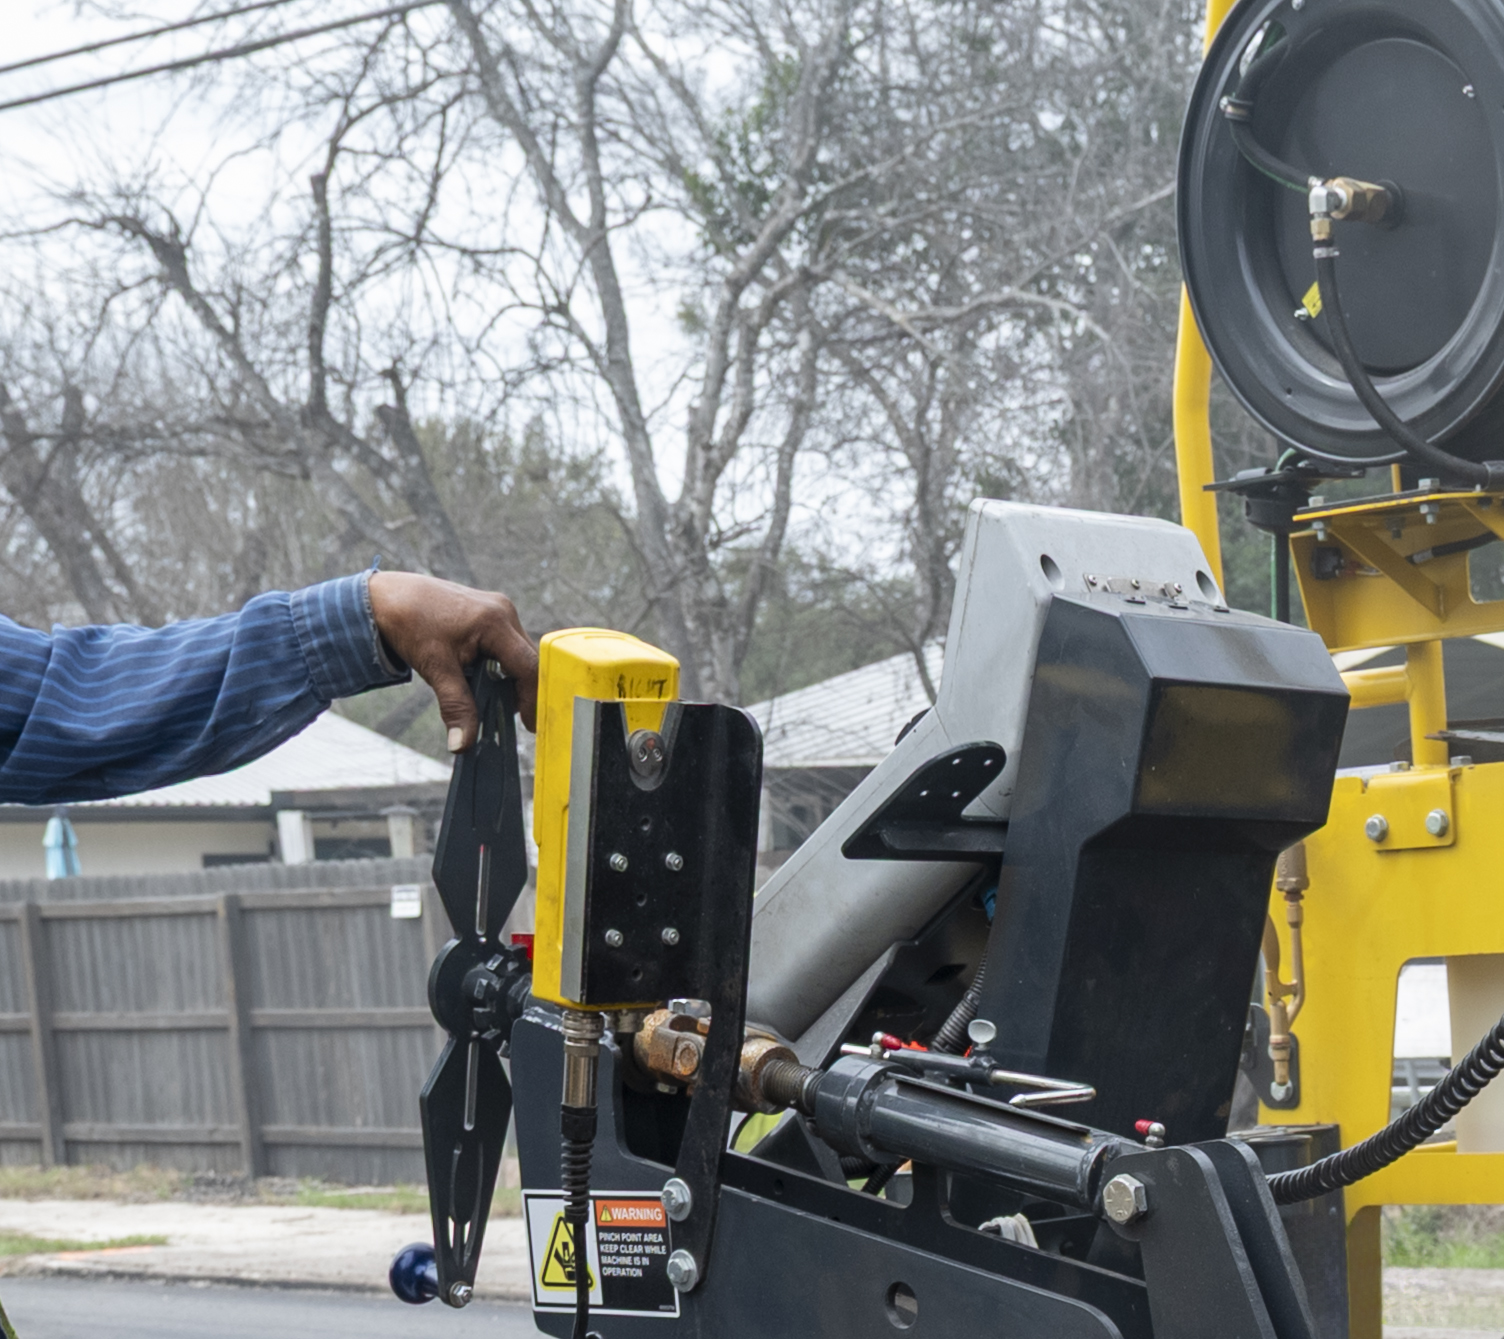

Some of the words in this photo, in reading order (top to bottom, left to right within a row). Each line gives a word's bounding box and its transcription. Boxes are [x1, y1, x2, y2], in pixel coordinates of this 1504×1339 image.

[611, 1207, 663, 1221] WARNING
[599, 1232, 620, 1242] PINCH
[621, 1233, 642, 1243] POINT
[643, 1233, 663, 1243] AREA
[600, 1244, 619, 1253] KEEP
[619, 1244, 643, 1254] CLEAR
[644, 1245, 667, 1255] WHILE
[601, 1255, 632, 1265] MACHINE
[633, 1257, 641, 1266] IS
[642, 1257, 650, 1266] IN
[602, 1267, 643, 1277] OPERATION
